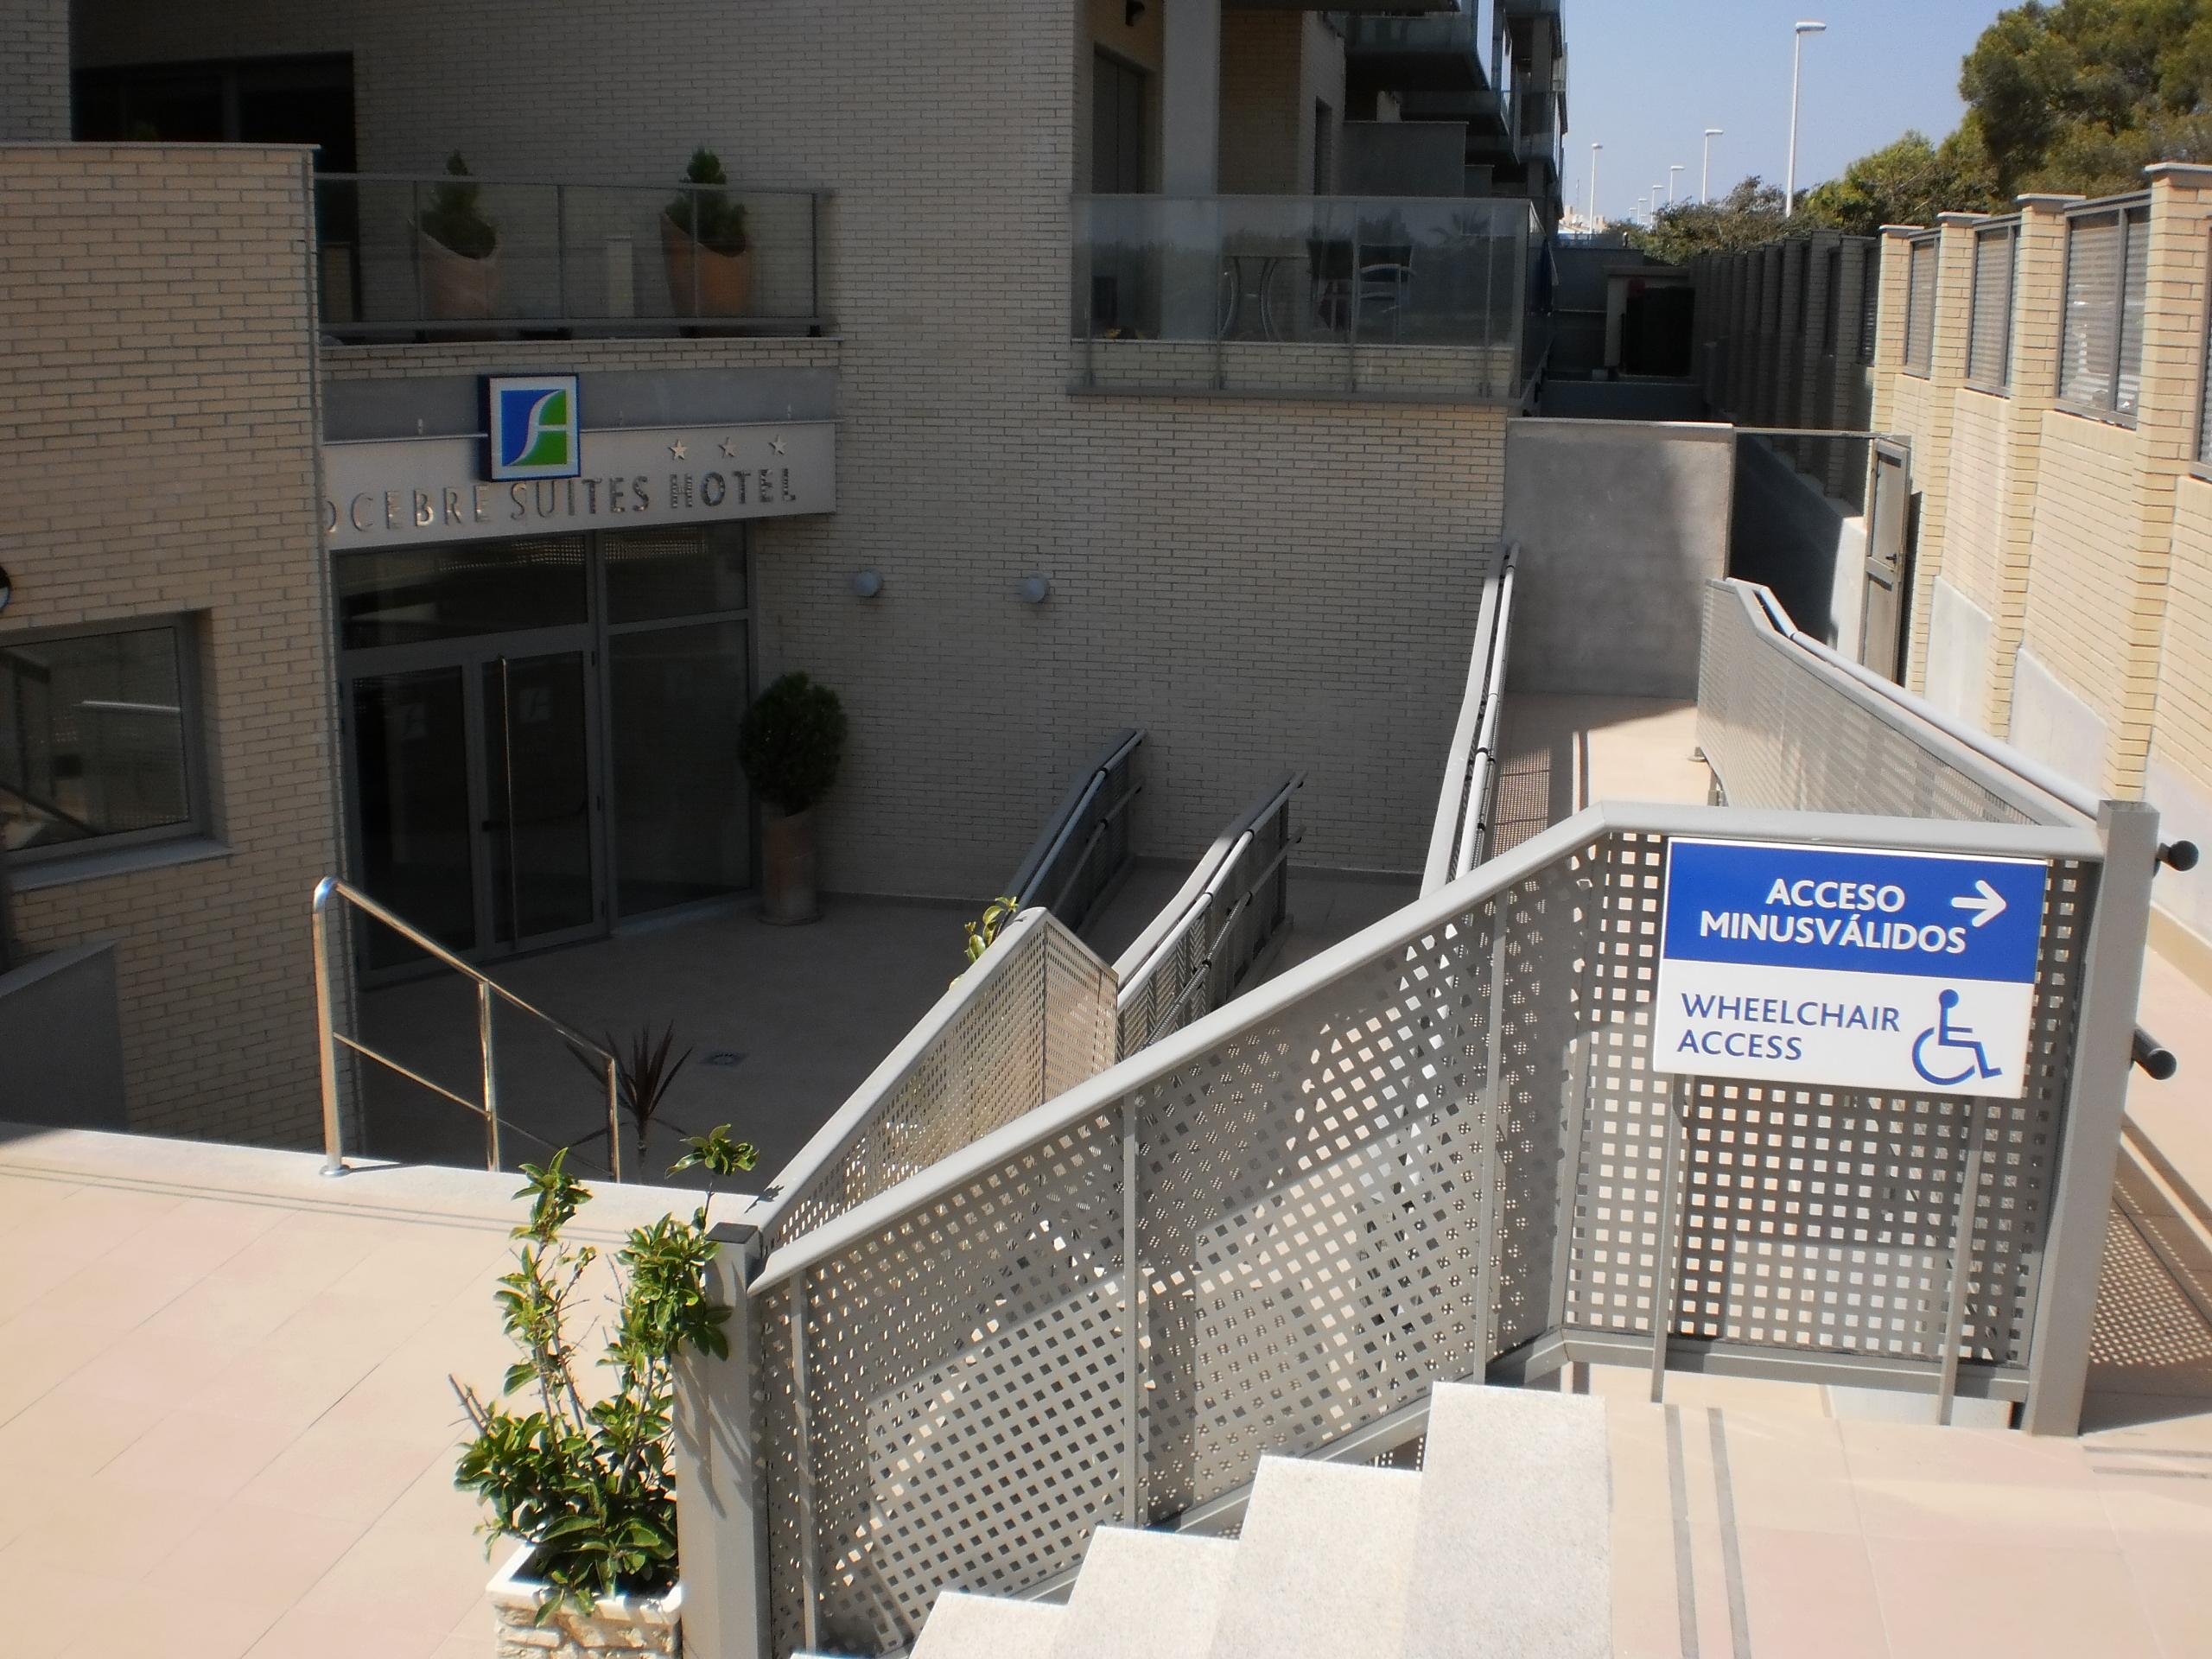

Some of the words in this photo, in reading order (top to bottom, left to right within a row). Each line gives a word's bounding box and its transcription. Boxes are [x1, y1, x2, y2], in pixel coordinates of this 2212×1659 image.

[511, 475, 650, 520] SUITES
[671, 468, 796, 509] HOTEL
[1766, 879, 1904, 912] ACCESO
[1700, 912, 1966, 954] MINUSVÁLIDOS
[1681, 993, 1900, 1032] WHEELCHAIR
[1677, 1029, 1802, 1060] ACCESS
